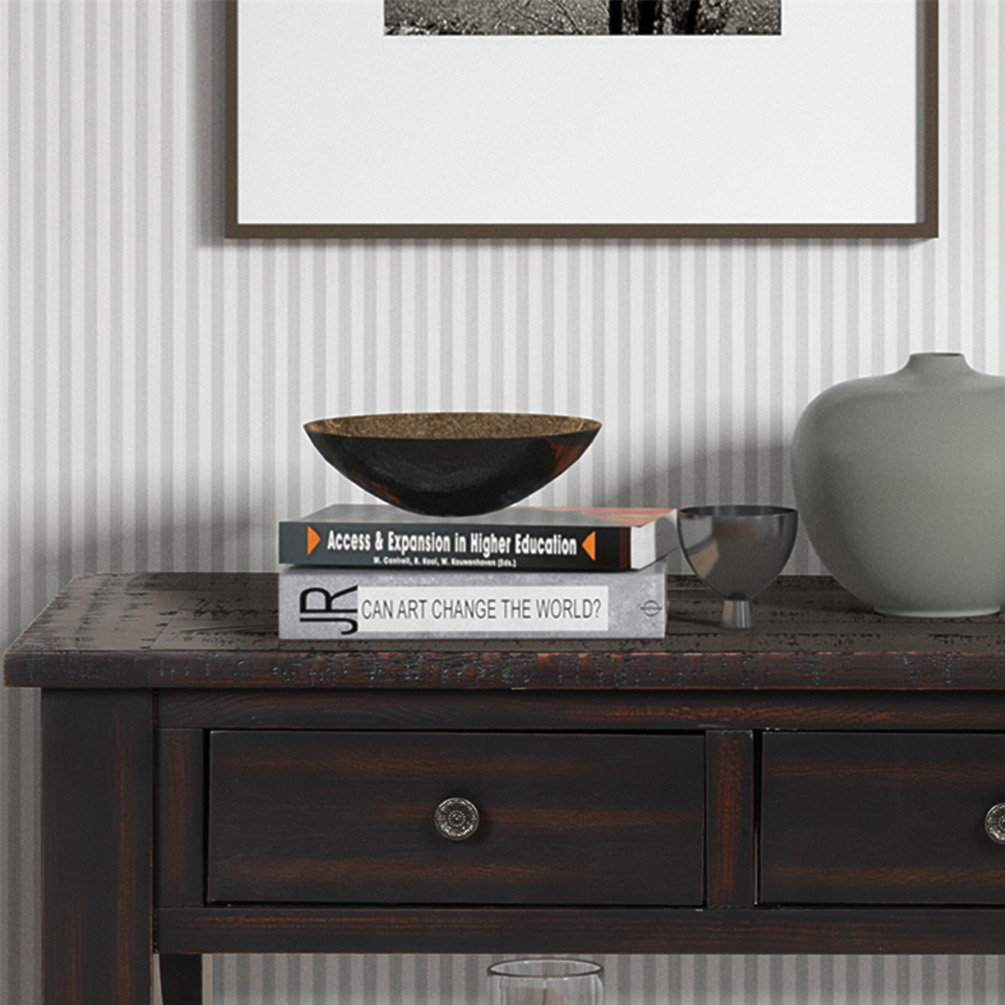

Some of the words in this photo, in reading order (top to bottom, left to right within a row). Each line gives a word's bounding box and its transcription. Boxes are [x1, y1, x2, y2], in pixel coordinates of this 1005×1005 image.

[327, 530, 371, 551] Access
[375, 530, 383, 551] &
[388, 531, 451, 556] Expansion
[455, 532, 466, 552] in
[470, 532, 511, 558] Higher
[515, 533, 577, 555] Education
[299, 585, 358, 635] JR
[361, 599, 394, 620] CAN
[396, 599, 428, 620] ART
[431, 598, 497, 620] CHANGE
[500, 598, 532, 620] THE
[535, 598, 602, 620] WORLD?
